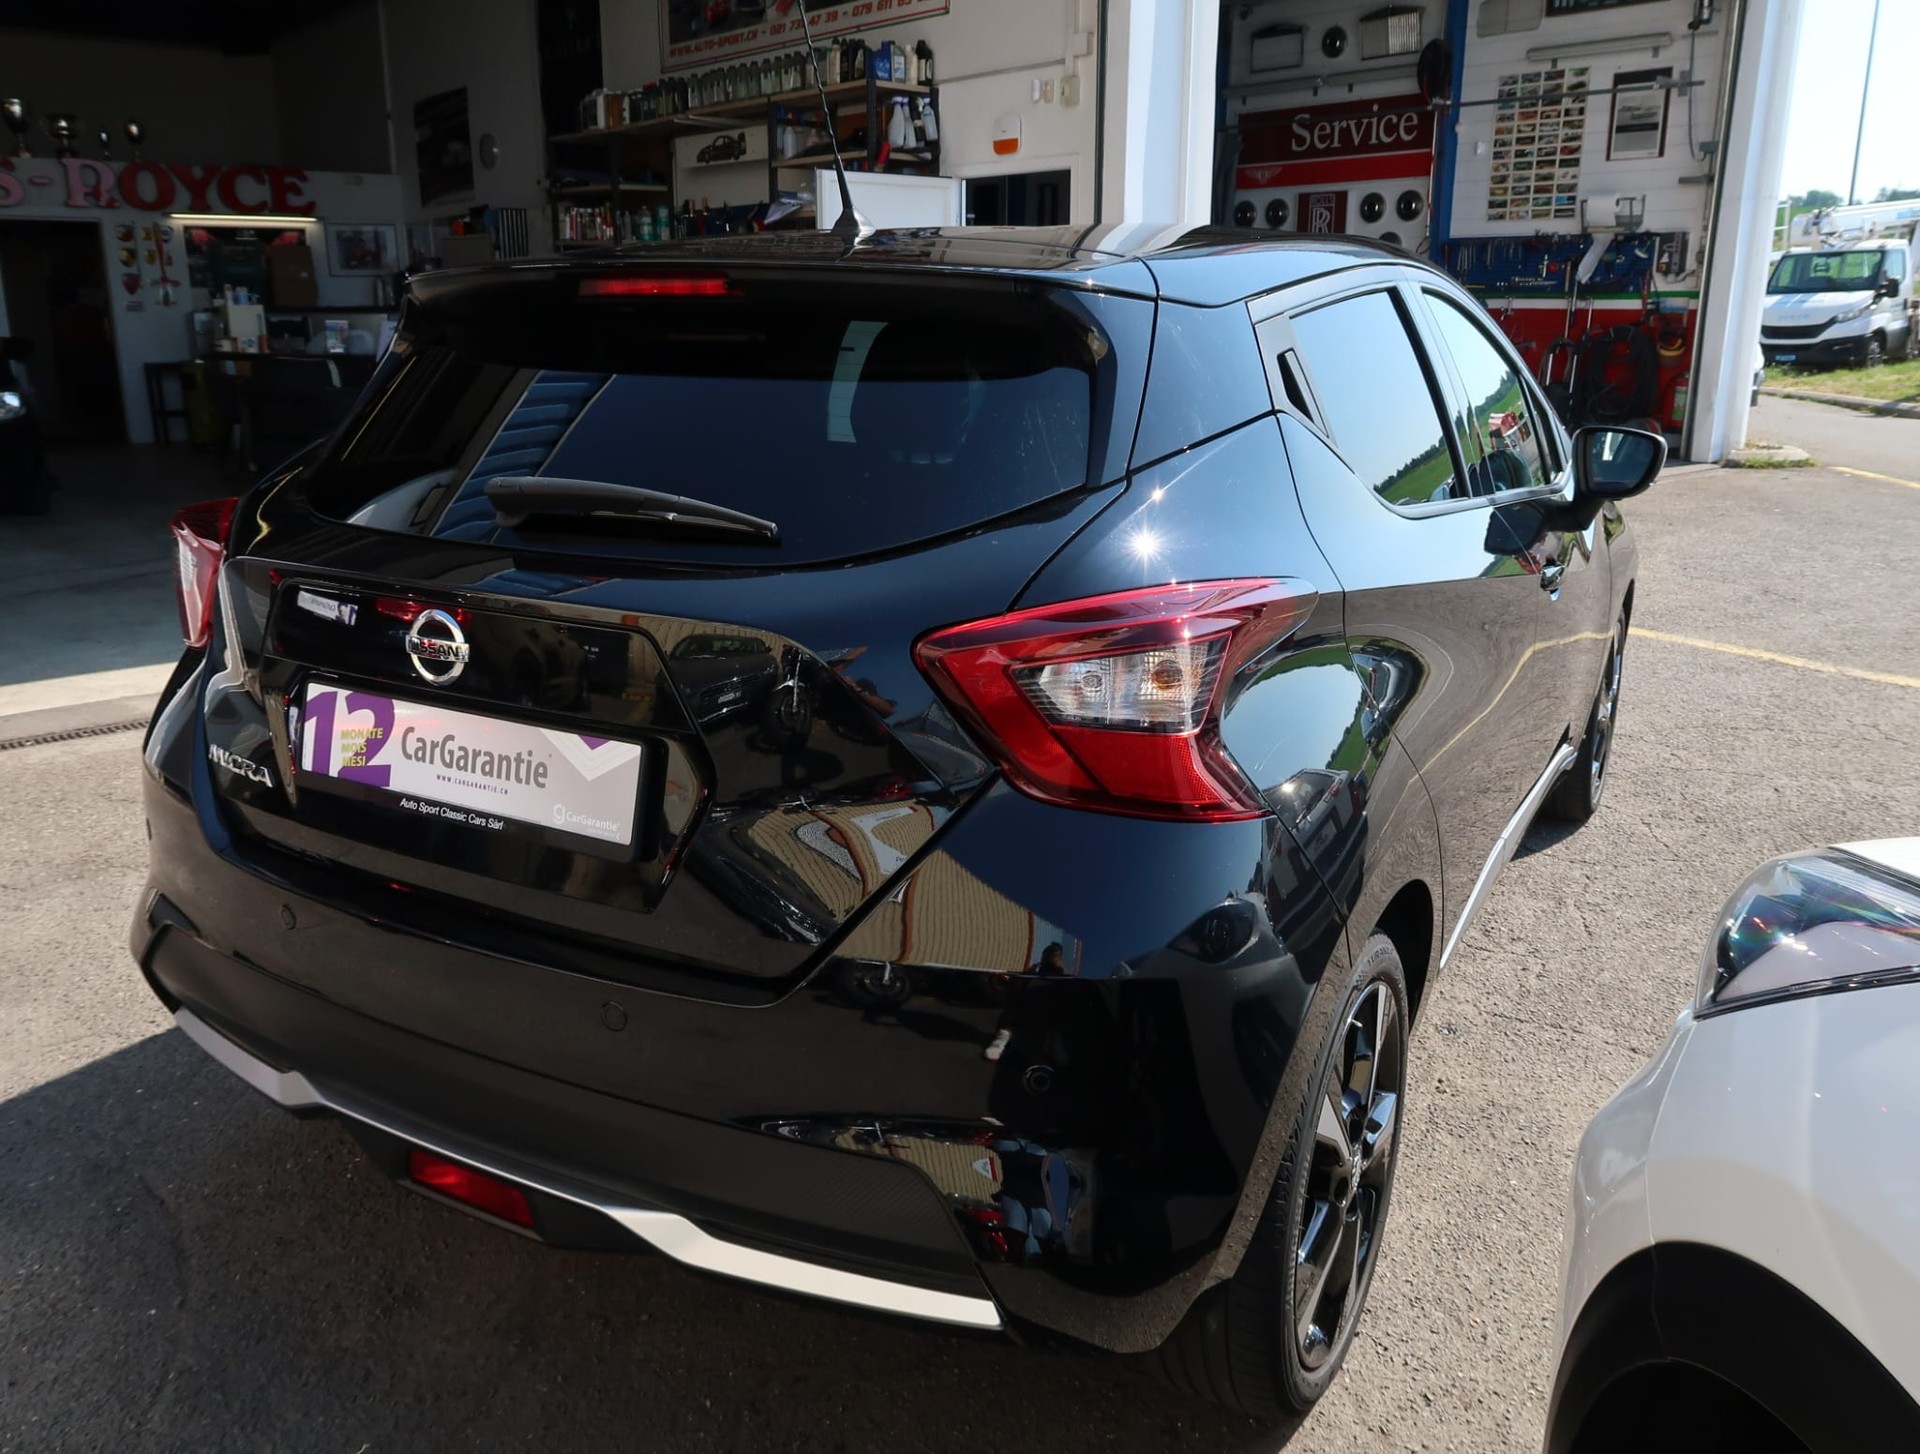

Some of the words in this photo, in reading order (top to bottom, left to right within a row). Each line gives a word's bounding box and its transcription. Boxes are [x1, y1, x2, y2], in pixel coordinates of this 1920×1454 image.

[1291, 103, 1419, 151] Service
[408, 637, 459, 658] NISSAN
[304, 691, 395, 787] 12
[341, 728, 384, 740] MONATE
[341, 742, 367, 754] MOIS
[400, 726, 549, 789] CarGarantie
[342, 756, 366, 768] MESI
[399, 798, 418, 810] Auto
[418, 802, 440, 815] Sport
[440, 807, 468, 822] Classic
[468, 813, 487, 826] Cars
[566, 811, 618, 832] CarGarantie
